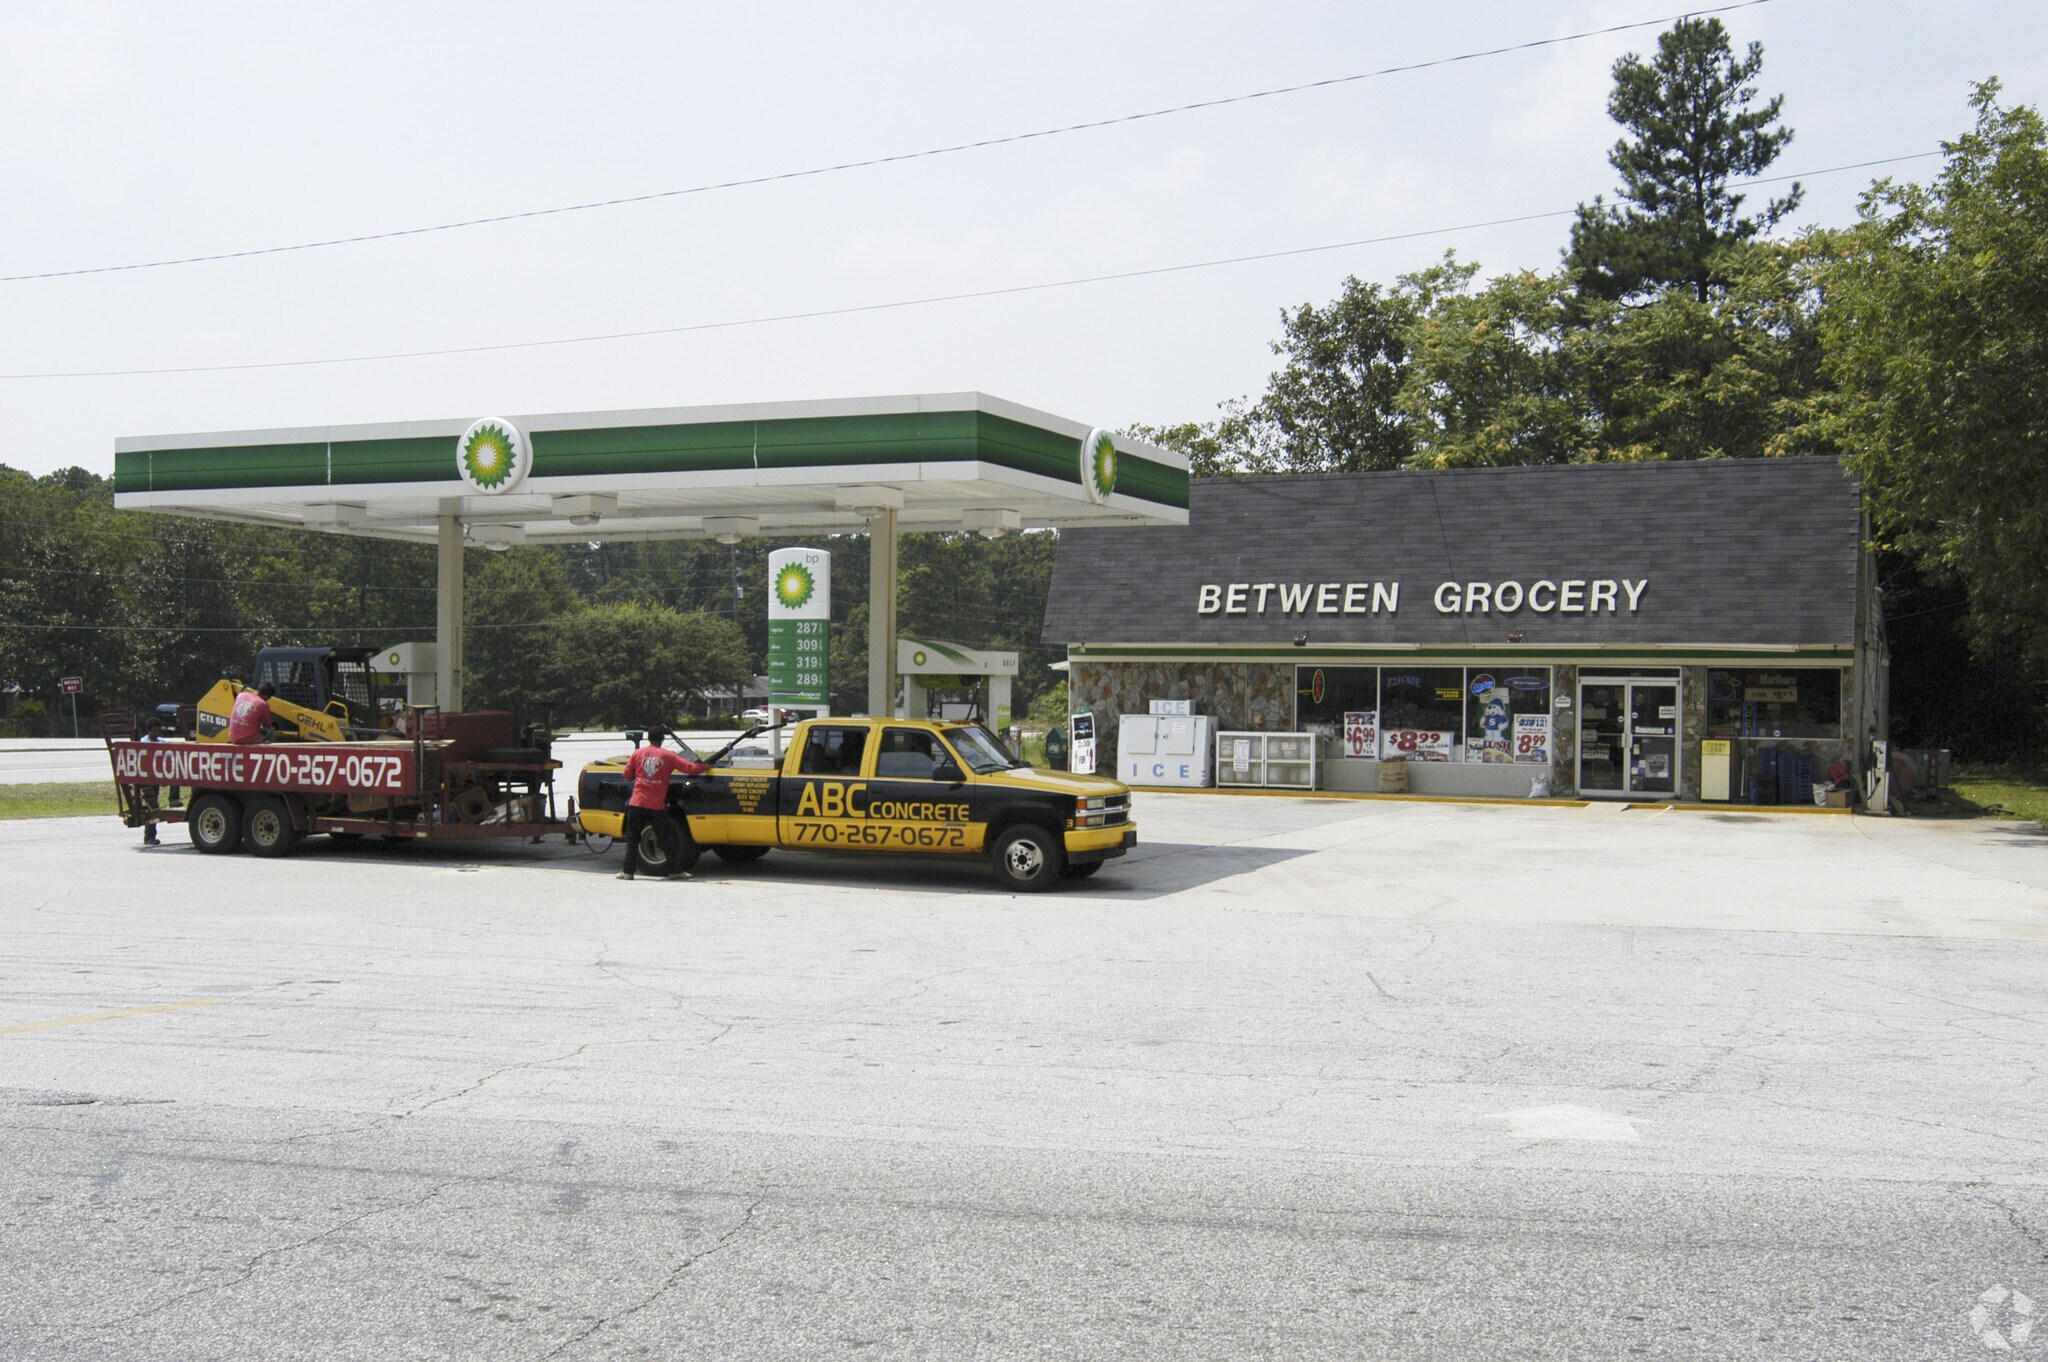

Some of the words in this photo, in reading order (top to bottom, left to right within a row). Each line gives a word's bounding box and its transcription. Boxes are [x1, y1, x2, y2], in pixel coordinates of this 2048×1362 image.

[805, 553, 819, 565] bp
[1197, 582, 1400, 614] BETWEEN
[1434, 579, 1648, 613] GROCERY
[796, 622, 818, 634] 287
[796, 639, 818, 651] 309
[796, 656, 818, 668] 319
[1002, 659, 1016, 667] SELF
[796, 673, 818, 685] 289
[1760, 673, 1797, 686] Marlboro
[1154, 701, 1185, 714] ICE
[200, 712, 214, 724] CTL
[215, 716, 227, 727] 60
[296, 712, 327, 733] GEHL
[1489, 718, 1496, 726] S
[1483, 740, 1511, 750] LUSH
[116, 749, 148, 778] ABC
[152, 750, 245, 783] CONCRETE
[250, 753, 402, 788] 770-267-0672
[1132, 763, 1190, 779] ICE
[796, 781, 867, 818] ABC
[869, 801, 970, 821] CONCRETE
[1066, 819, 1074, 827] 3
[794, 822, 965, 847] 770-267-0672
